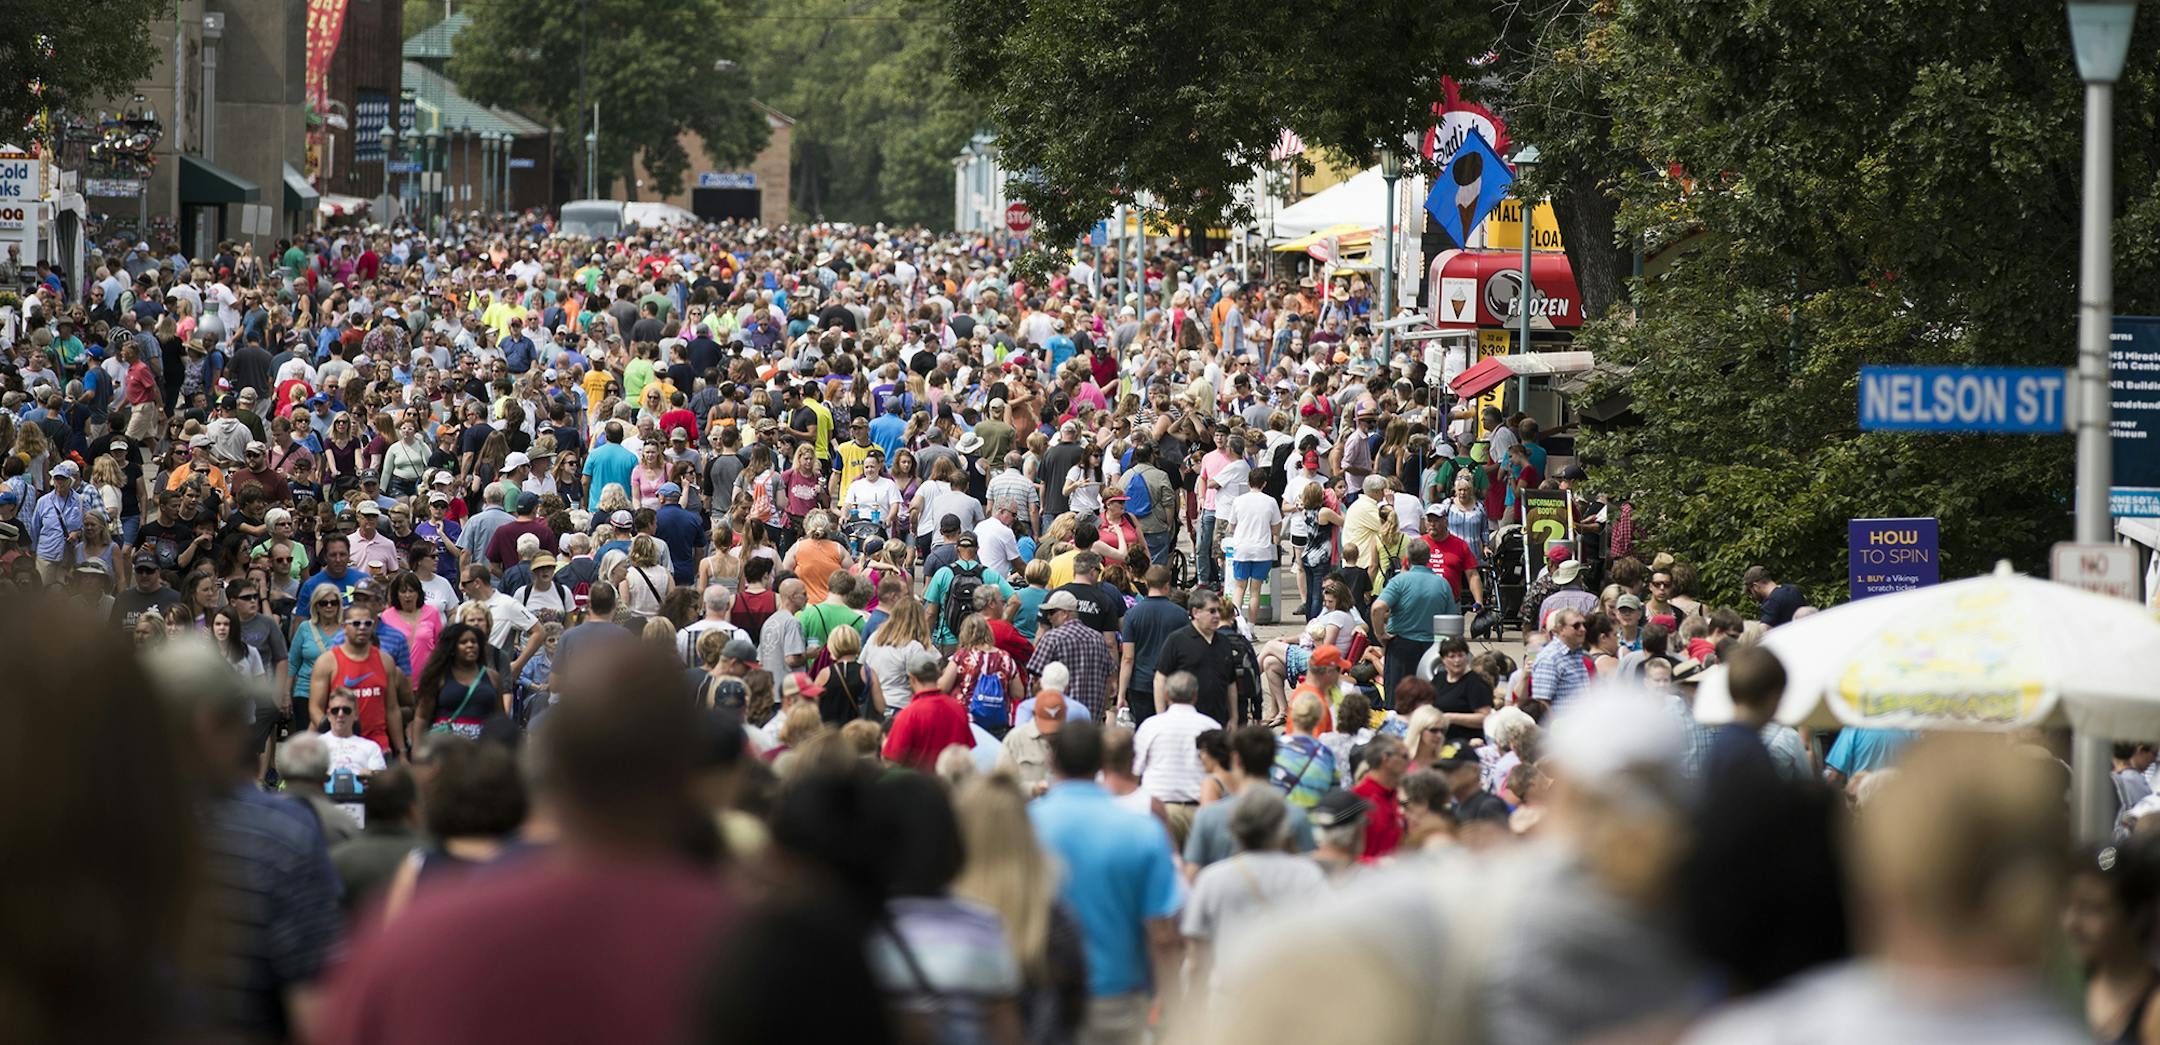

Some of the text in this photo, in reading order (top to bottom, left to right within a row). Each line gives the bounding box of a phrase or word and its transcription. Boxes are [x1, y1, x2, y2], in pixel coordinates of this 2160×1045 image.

[0, 208, 24, 220] OG
[2109, 333, 2133, 341] arns
[2130, 361, 2160, 371] Cente
[1864, 374, 2061, 425] NELSON ST
[1528, 498, 1565, 507] INFORMATION
[1537, 507, 1557, 515] BOOTH
[2110, 504, 2131, 514] ATE
[1870, 530, 1918, 545] HOW
[1860, 548, 1929, 564] TO SPIN
[2080, 553, 2109, 577] NO
[1867, 575, 1885, 583] BUY
[1892, 575, 1919, 584] Vikings
